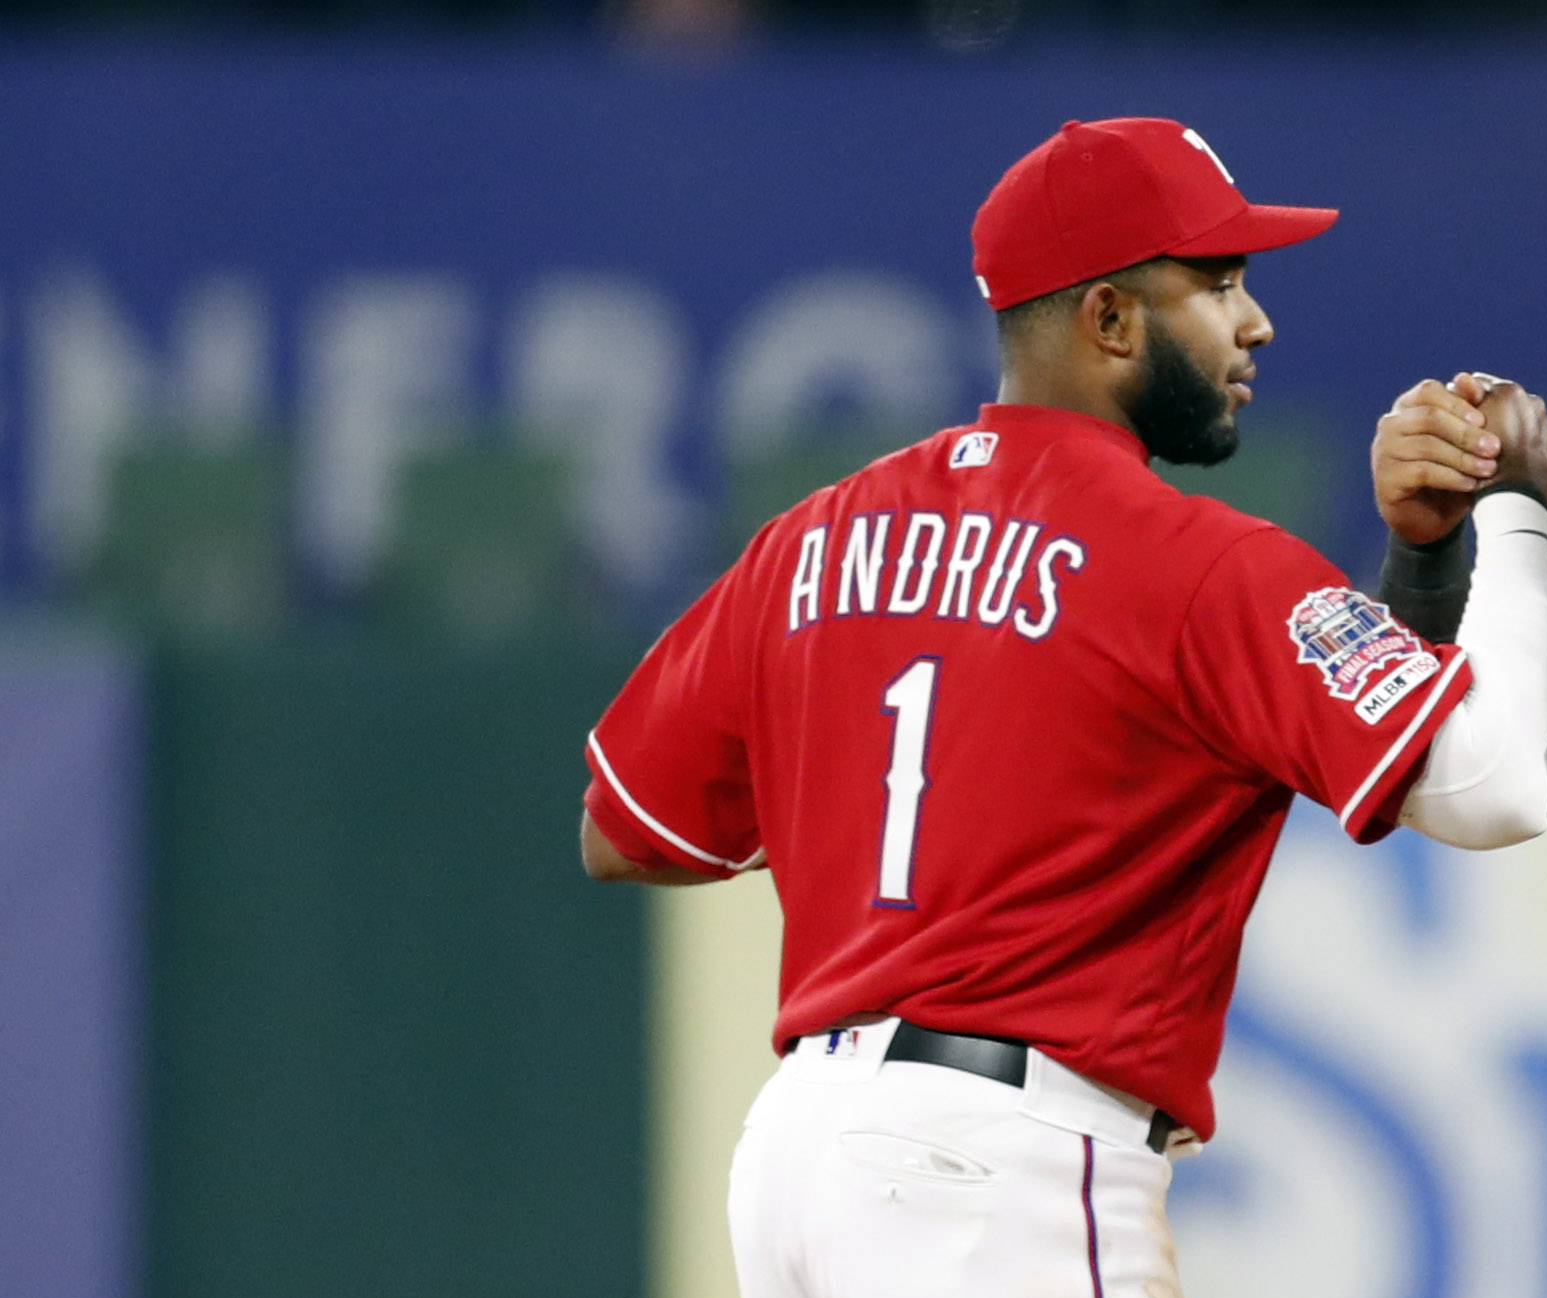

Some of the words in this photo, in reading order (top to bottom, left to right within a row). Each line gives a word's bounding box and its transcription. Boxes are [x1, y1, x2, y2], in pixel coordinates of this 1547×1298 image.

[787, 508, 1087, 643] ANDRUS
[1338, 656, 1366, 685] FINAL
[1362, 635, 1407, 663] SEASON
[1364, 681, 1398, 716] MLB
[871, 654, 944, 910] 1
